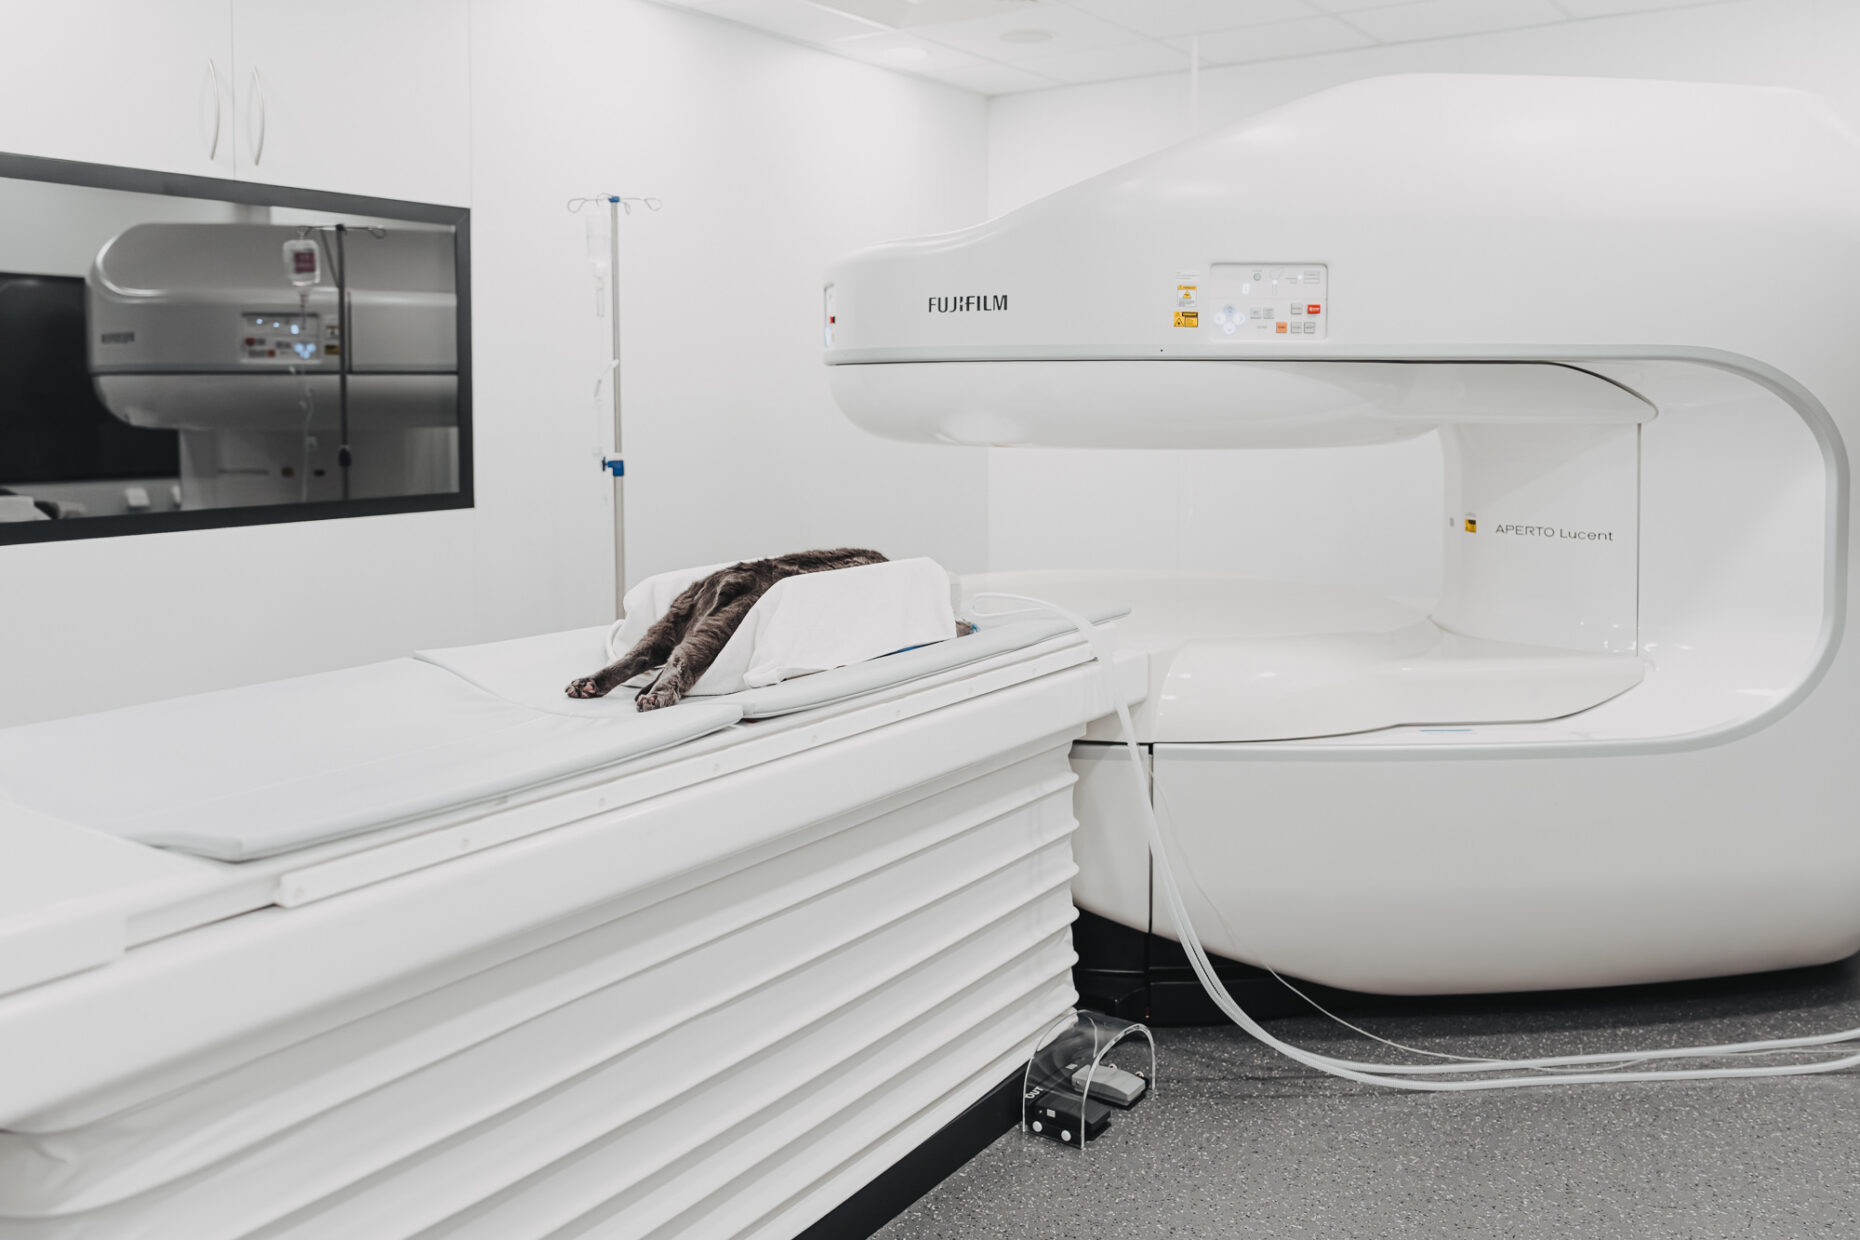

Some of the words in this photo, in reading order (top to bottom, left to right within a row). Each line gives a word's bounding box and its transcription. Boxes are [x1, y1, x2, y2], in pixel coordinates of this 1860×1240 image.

[928, 294, 1008, 313] FUJIFILM
[1495, 523, 1555, 538] APERTO
[1559, 528, 1614, 542] Lucent
